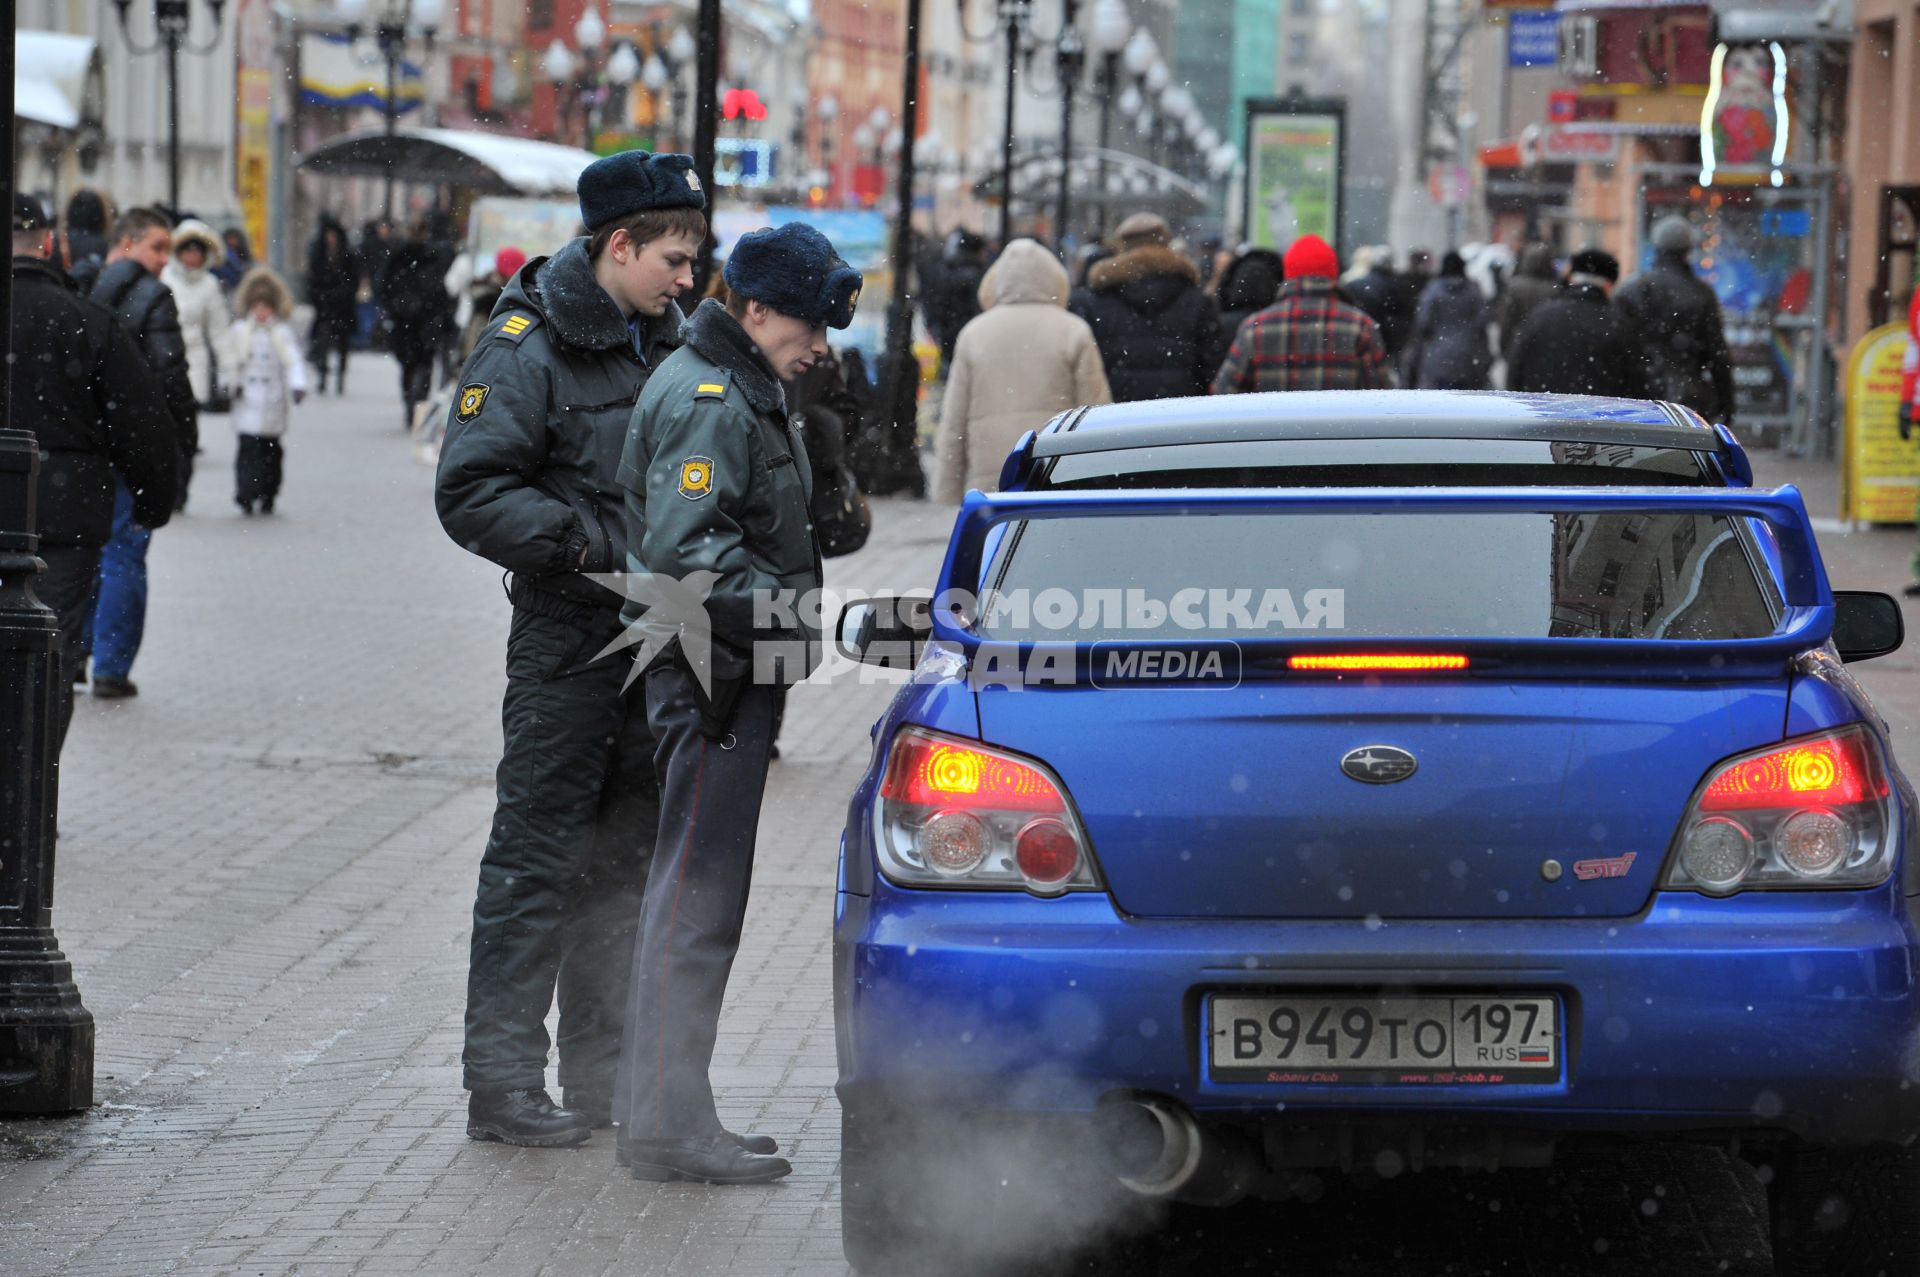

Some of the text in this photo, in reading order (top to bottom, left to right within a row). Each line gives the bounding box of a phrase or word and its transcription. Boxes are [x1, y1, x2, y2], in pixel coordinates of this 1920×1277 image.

[1460, 1004, 1539, 1044] 197
[1477, 1048, 1517, 1061] RUS
[1266, 1072, 1339, 1082] Subaru Club
